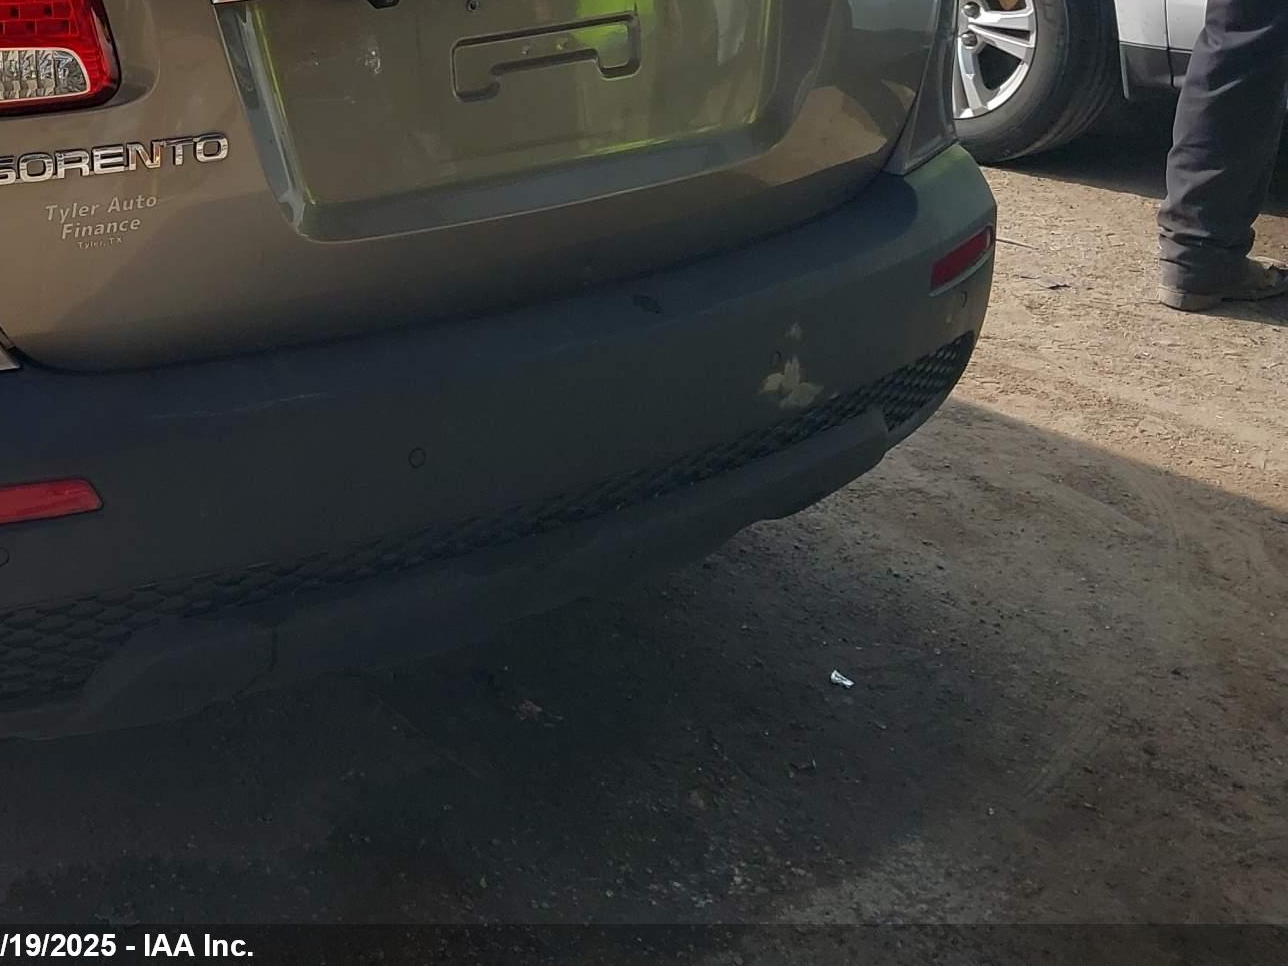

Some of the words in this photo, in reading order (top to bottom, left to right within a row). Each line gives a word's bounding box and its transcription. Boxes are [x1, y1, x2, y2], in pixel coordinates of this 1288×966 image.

[45, 202, 100, 224] Tyler
[107, 194, 158, 213] Auto
[61, 218, 141, 240] Finance
